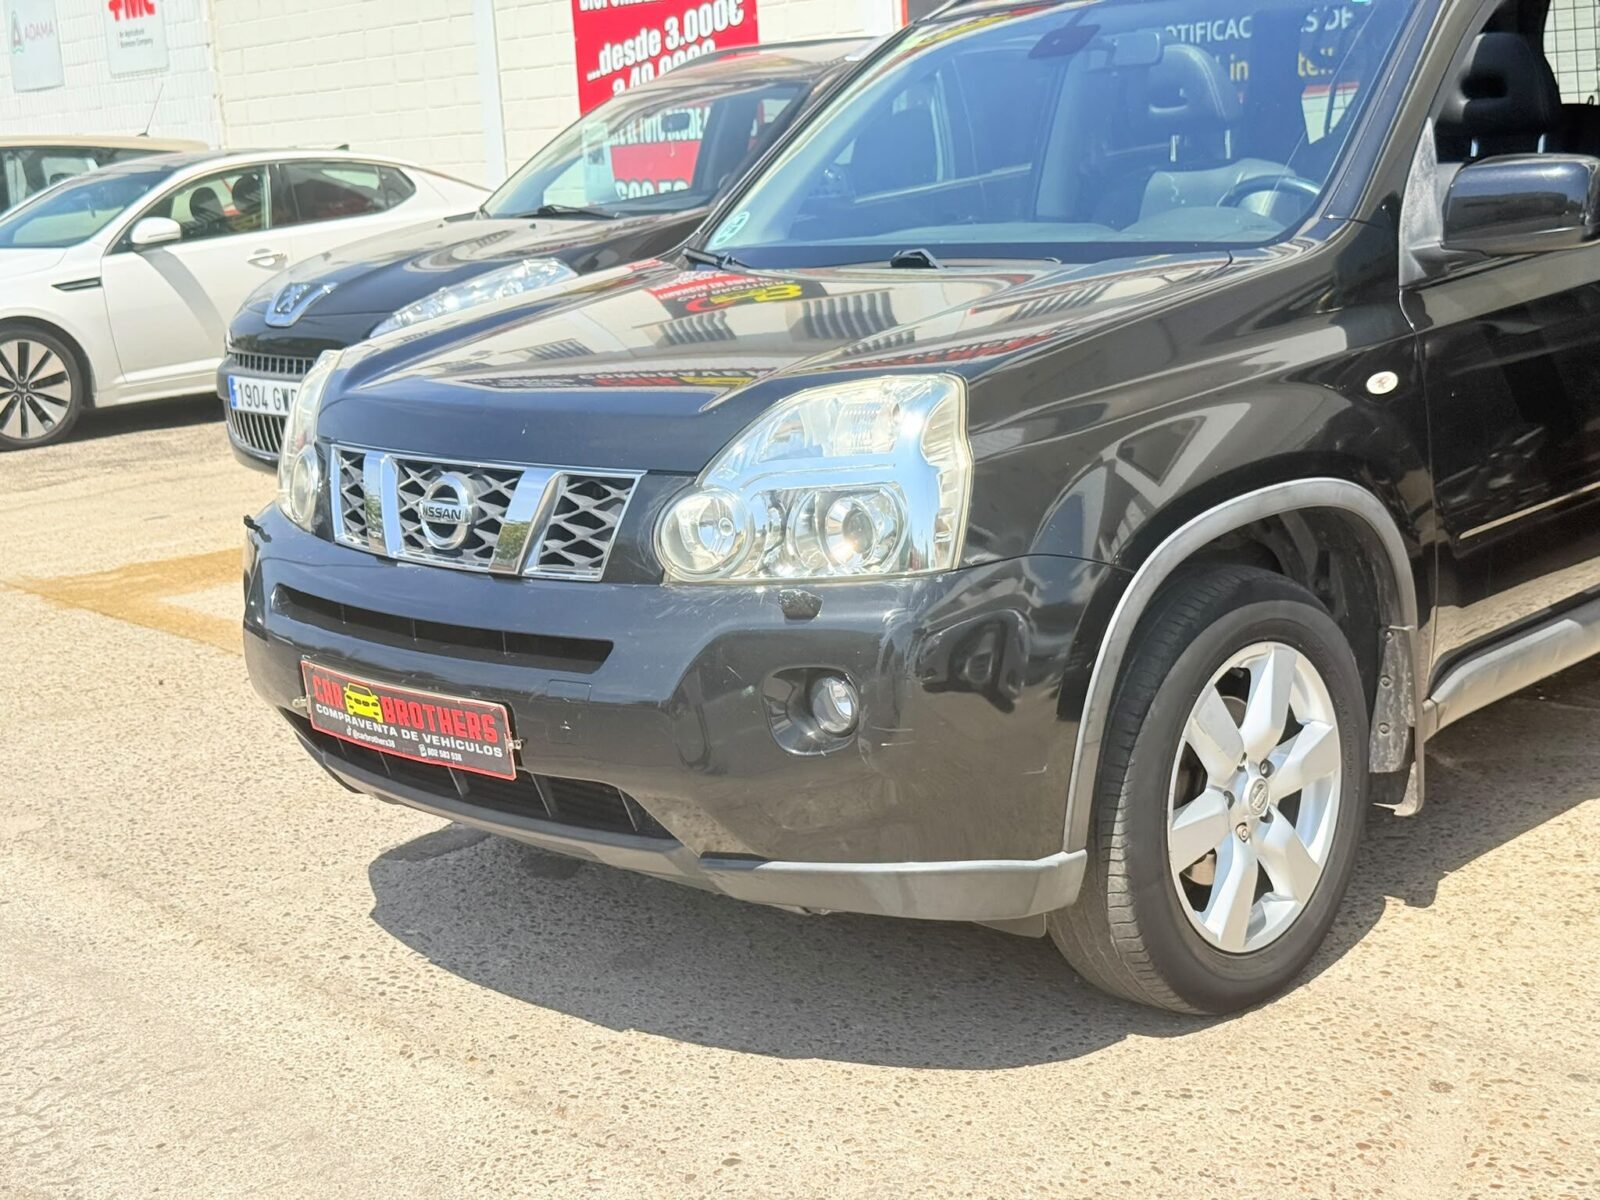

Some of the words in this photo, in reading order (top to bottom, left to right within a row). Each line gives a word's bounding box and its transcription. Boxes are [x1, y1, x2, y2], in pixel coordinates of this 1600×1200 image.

[664, 0, 745, 50] 3.000€
[239, 383, 269, 410] 1904
[312, 674, 345, 709] CAR
[380, 696, 499, 744] BROTHERS
[315, 703, 398, 738] COMPRAVENTA
[401, 728, 420, 743] DE
[422, 733, 503, 758] VEHÍCULOS
